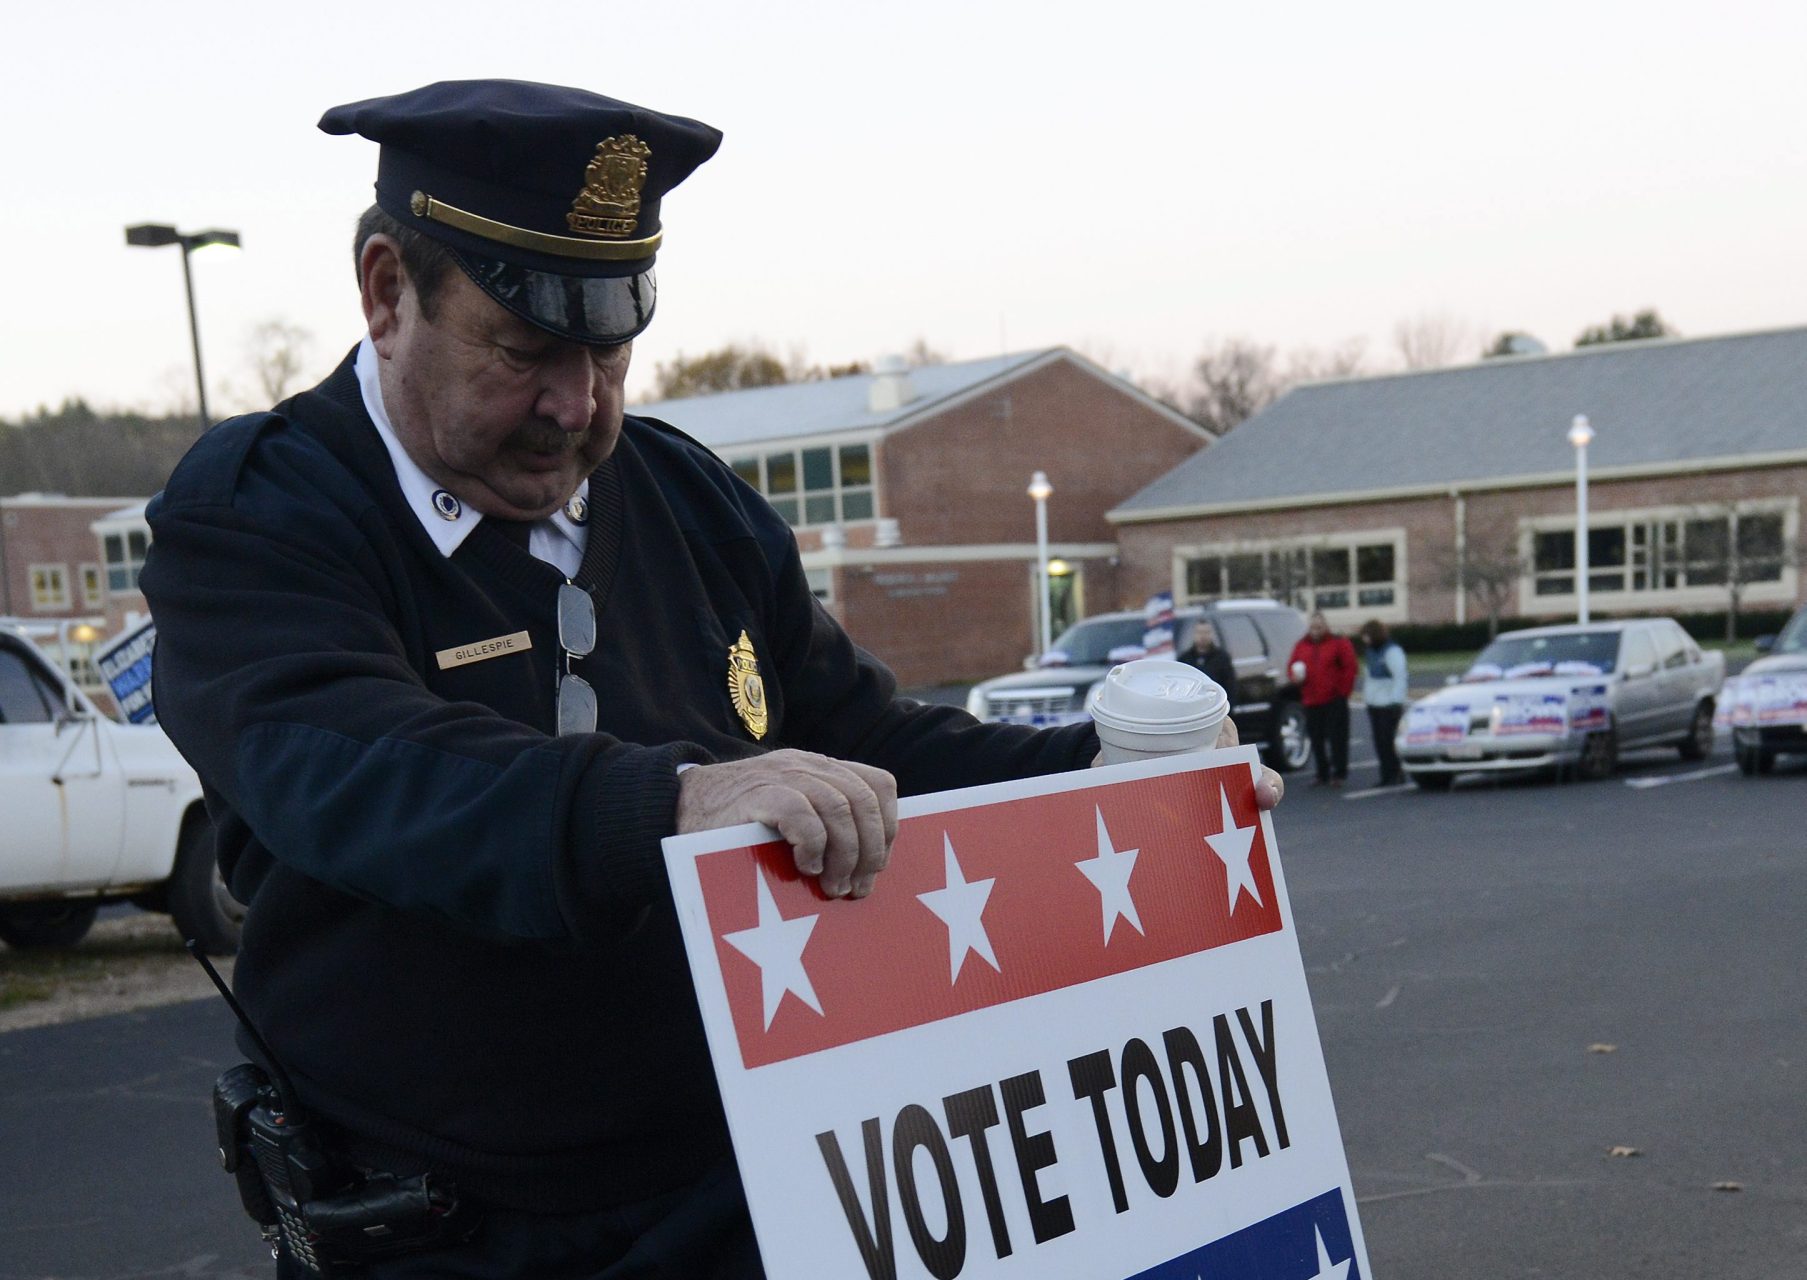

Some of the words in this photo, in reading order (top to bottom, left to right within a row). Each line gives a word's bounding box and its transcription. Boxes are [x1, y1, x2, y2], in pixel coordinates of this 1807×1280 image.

[575, 216, 633, 233] POLICE
[455, 638, 515, 660] GILLESPIE
[1067, 999, 1291, 1215] TODAY
